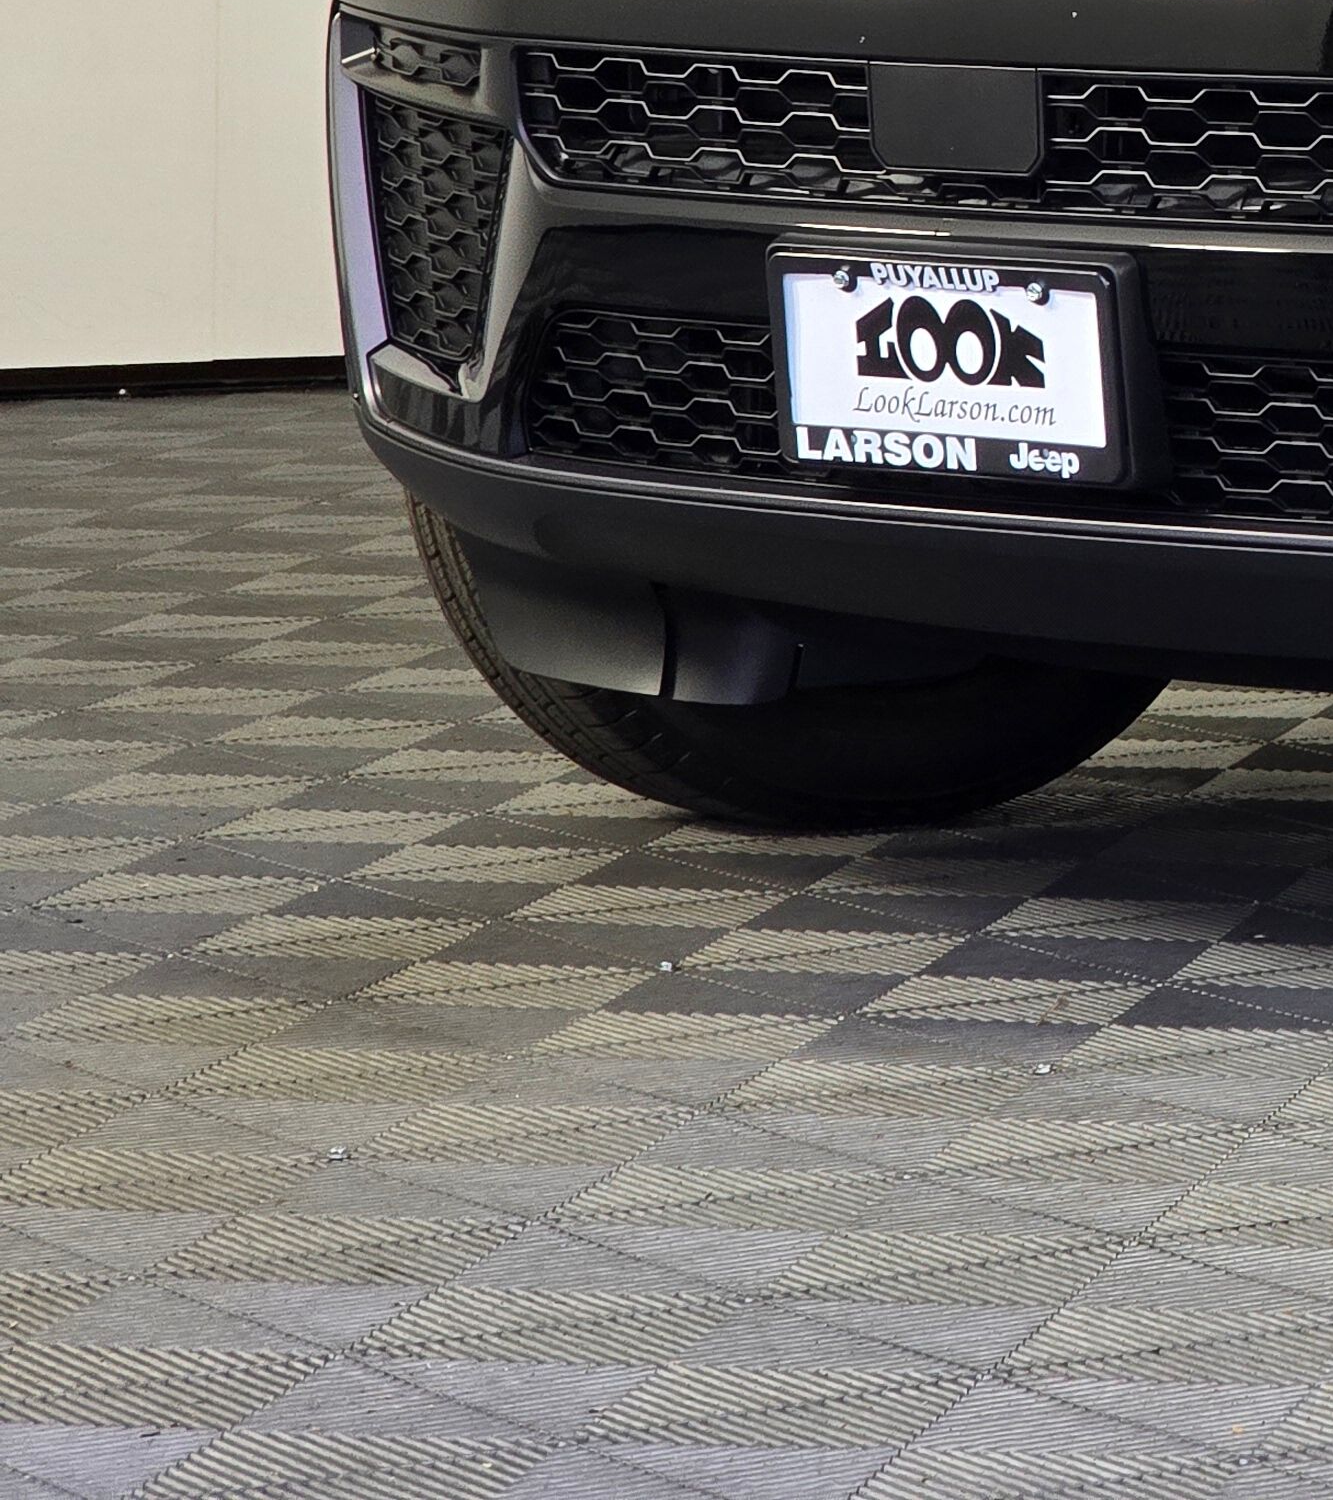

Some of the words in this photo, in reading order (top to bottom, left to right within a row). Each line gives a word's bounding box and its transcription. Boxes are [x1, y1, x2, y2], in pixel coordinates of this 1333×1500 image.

[870, 262, 1000, 293] PUYALLUP
[856, 295, 1046, 388] LOOK
[853, 386, 1057, 427] LookLarson.com
[796, 426, 978, 472] LARSON
[1009, 442, 1080, 479] Jeep
